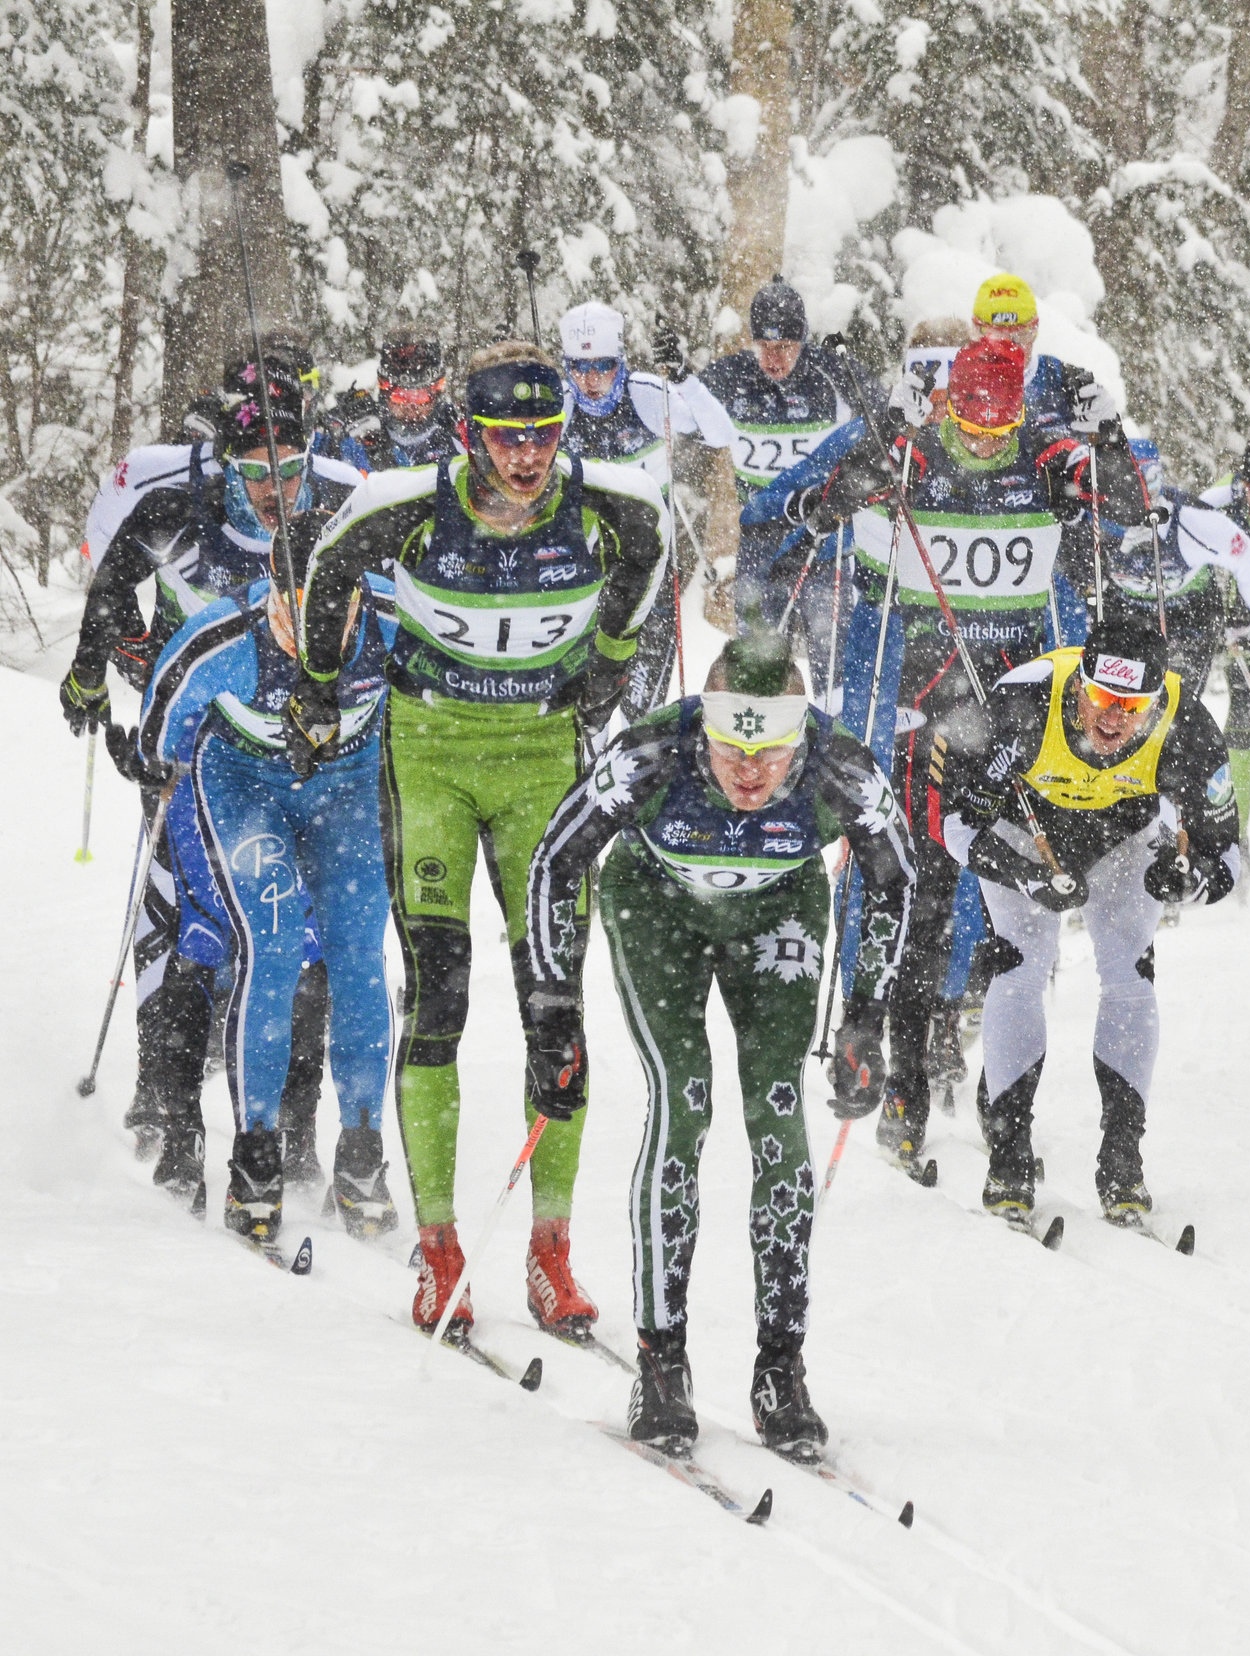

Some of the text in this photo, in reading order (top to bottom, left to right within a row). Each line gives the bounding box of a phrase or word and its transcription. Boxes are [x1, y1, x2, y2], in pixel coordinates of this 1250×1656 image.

[738, 436, 810, 470] 225
[931, 534, 1033, 587] 209
[433, 608, 573, 652] 213
[938, 620, 1025, 643] Caftsbury
[1098, 657, 1140, 685] Lilly
